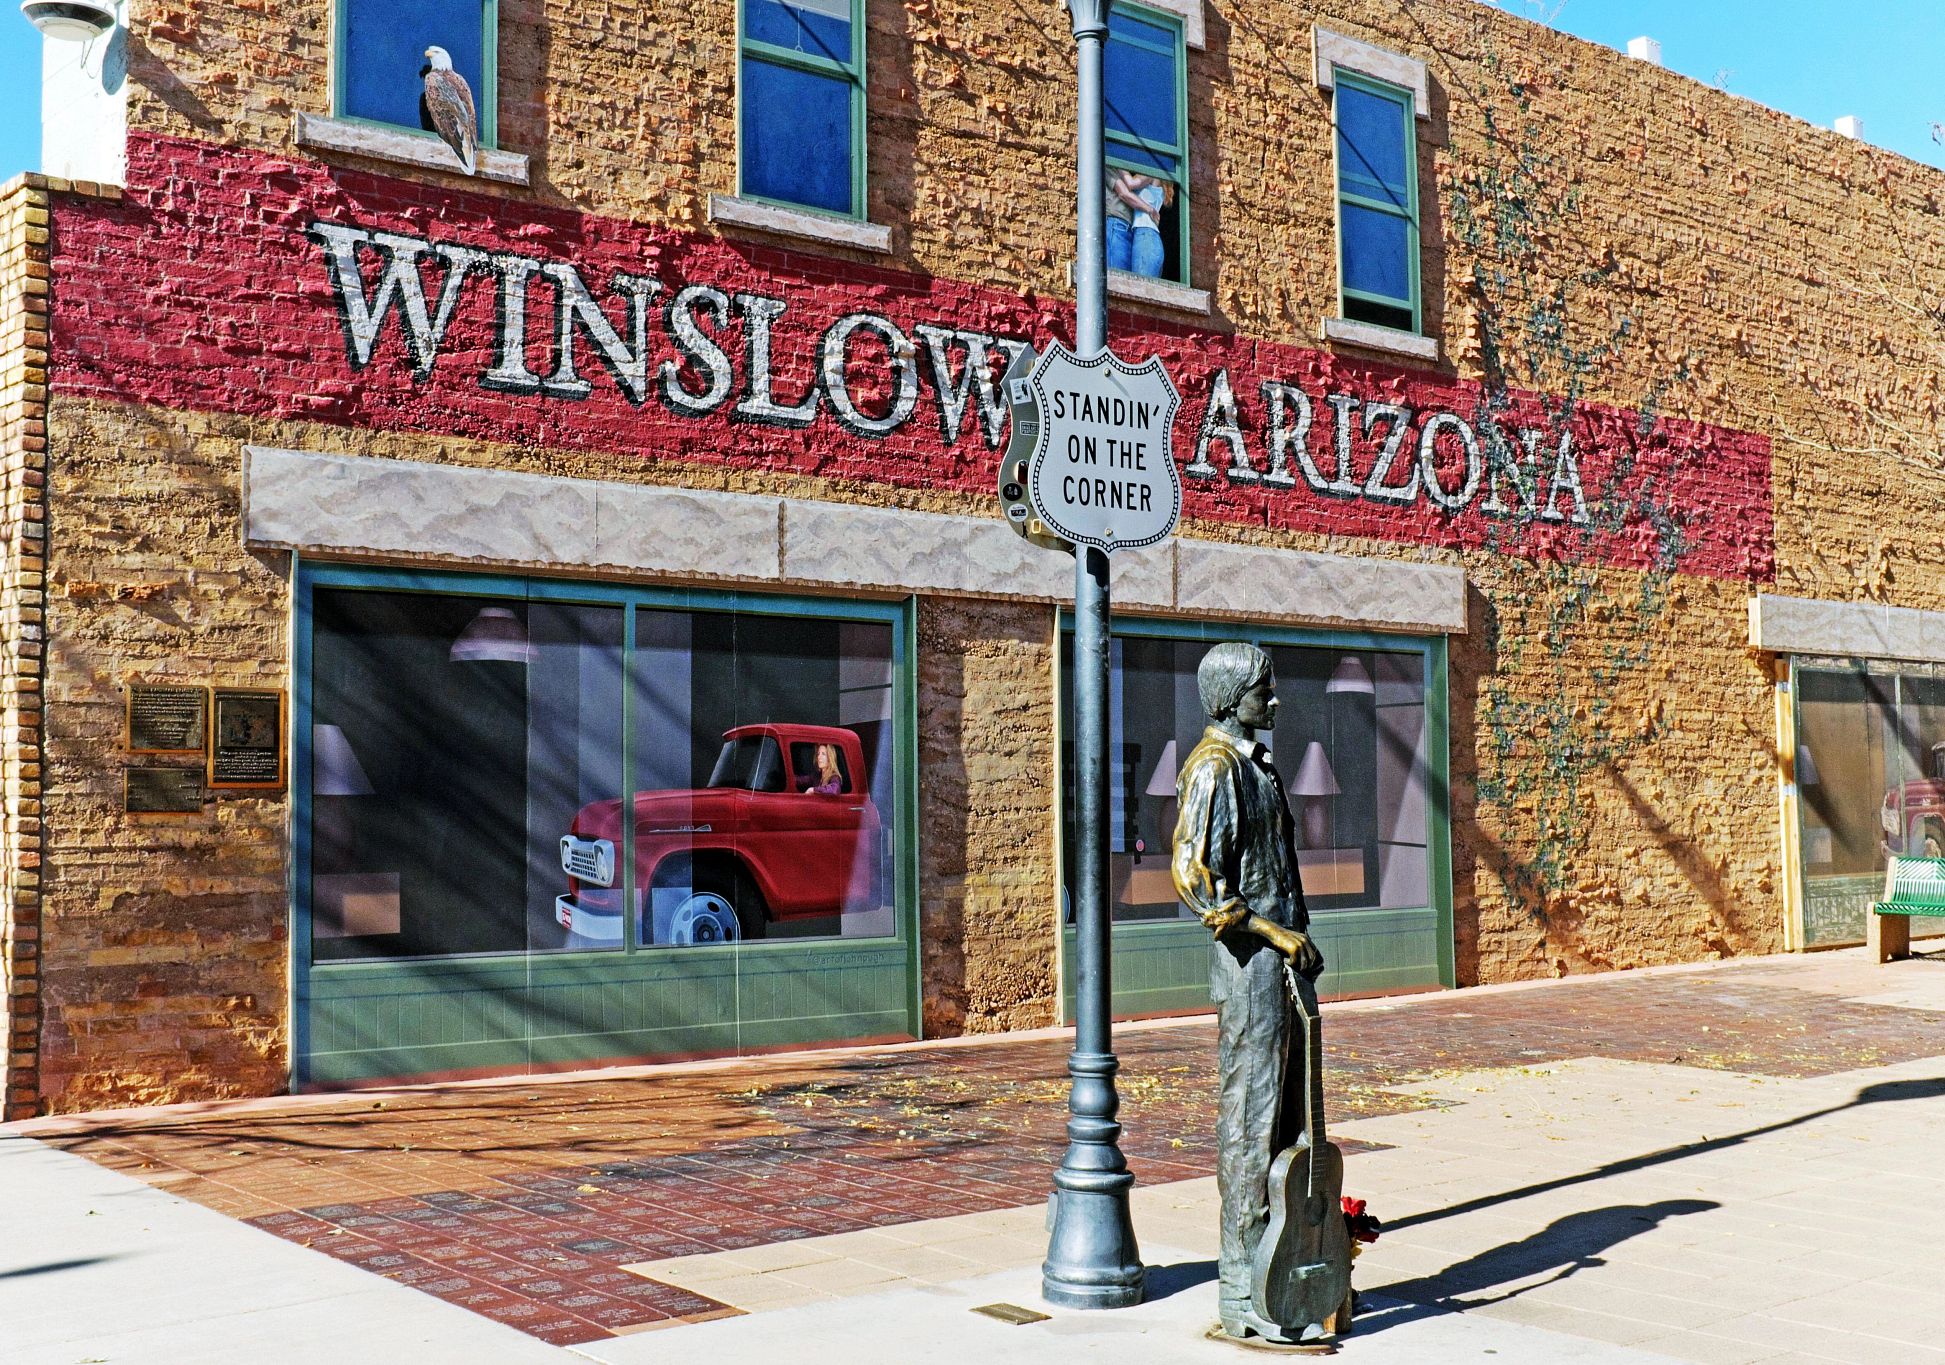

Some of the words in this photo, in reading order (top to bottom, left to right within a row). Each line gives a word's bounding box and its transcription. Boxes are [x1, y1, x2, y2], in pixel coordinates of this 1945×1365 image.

[307, 221, 1025, 449] WINSLOW
[1185, 367, 1591, 525] ARIZONA
[1053, 389, 1160, 430] STANDIN'
[1067, 434, 1097, 465] ON
[1106, 438, 1147, 471] THE
[1063, 475, 1152, 513] CORNER
